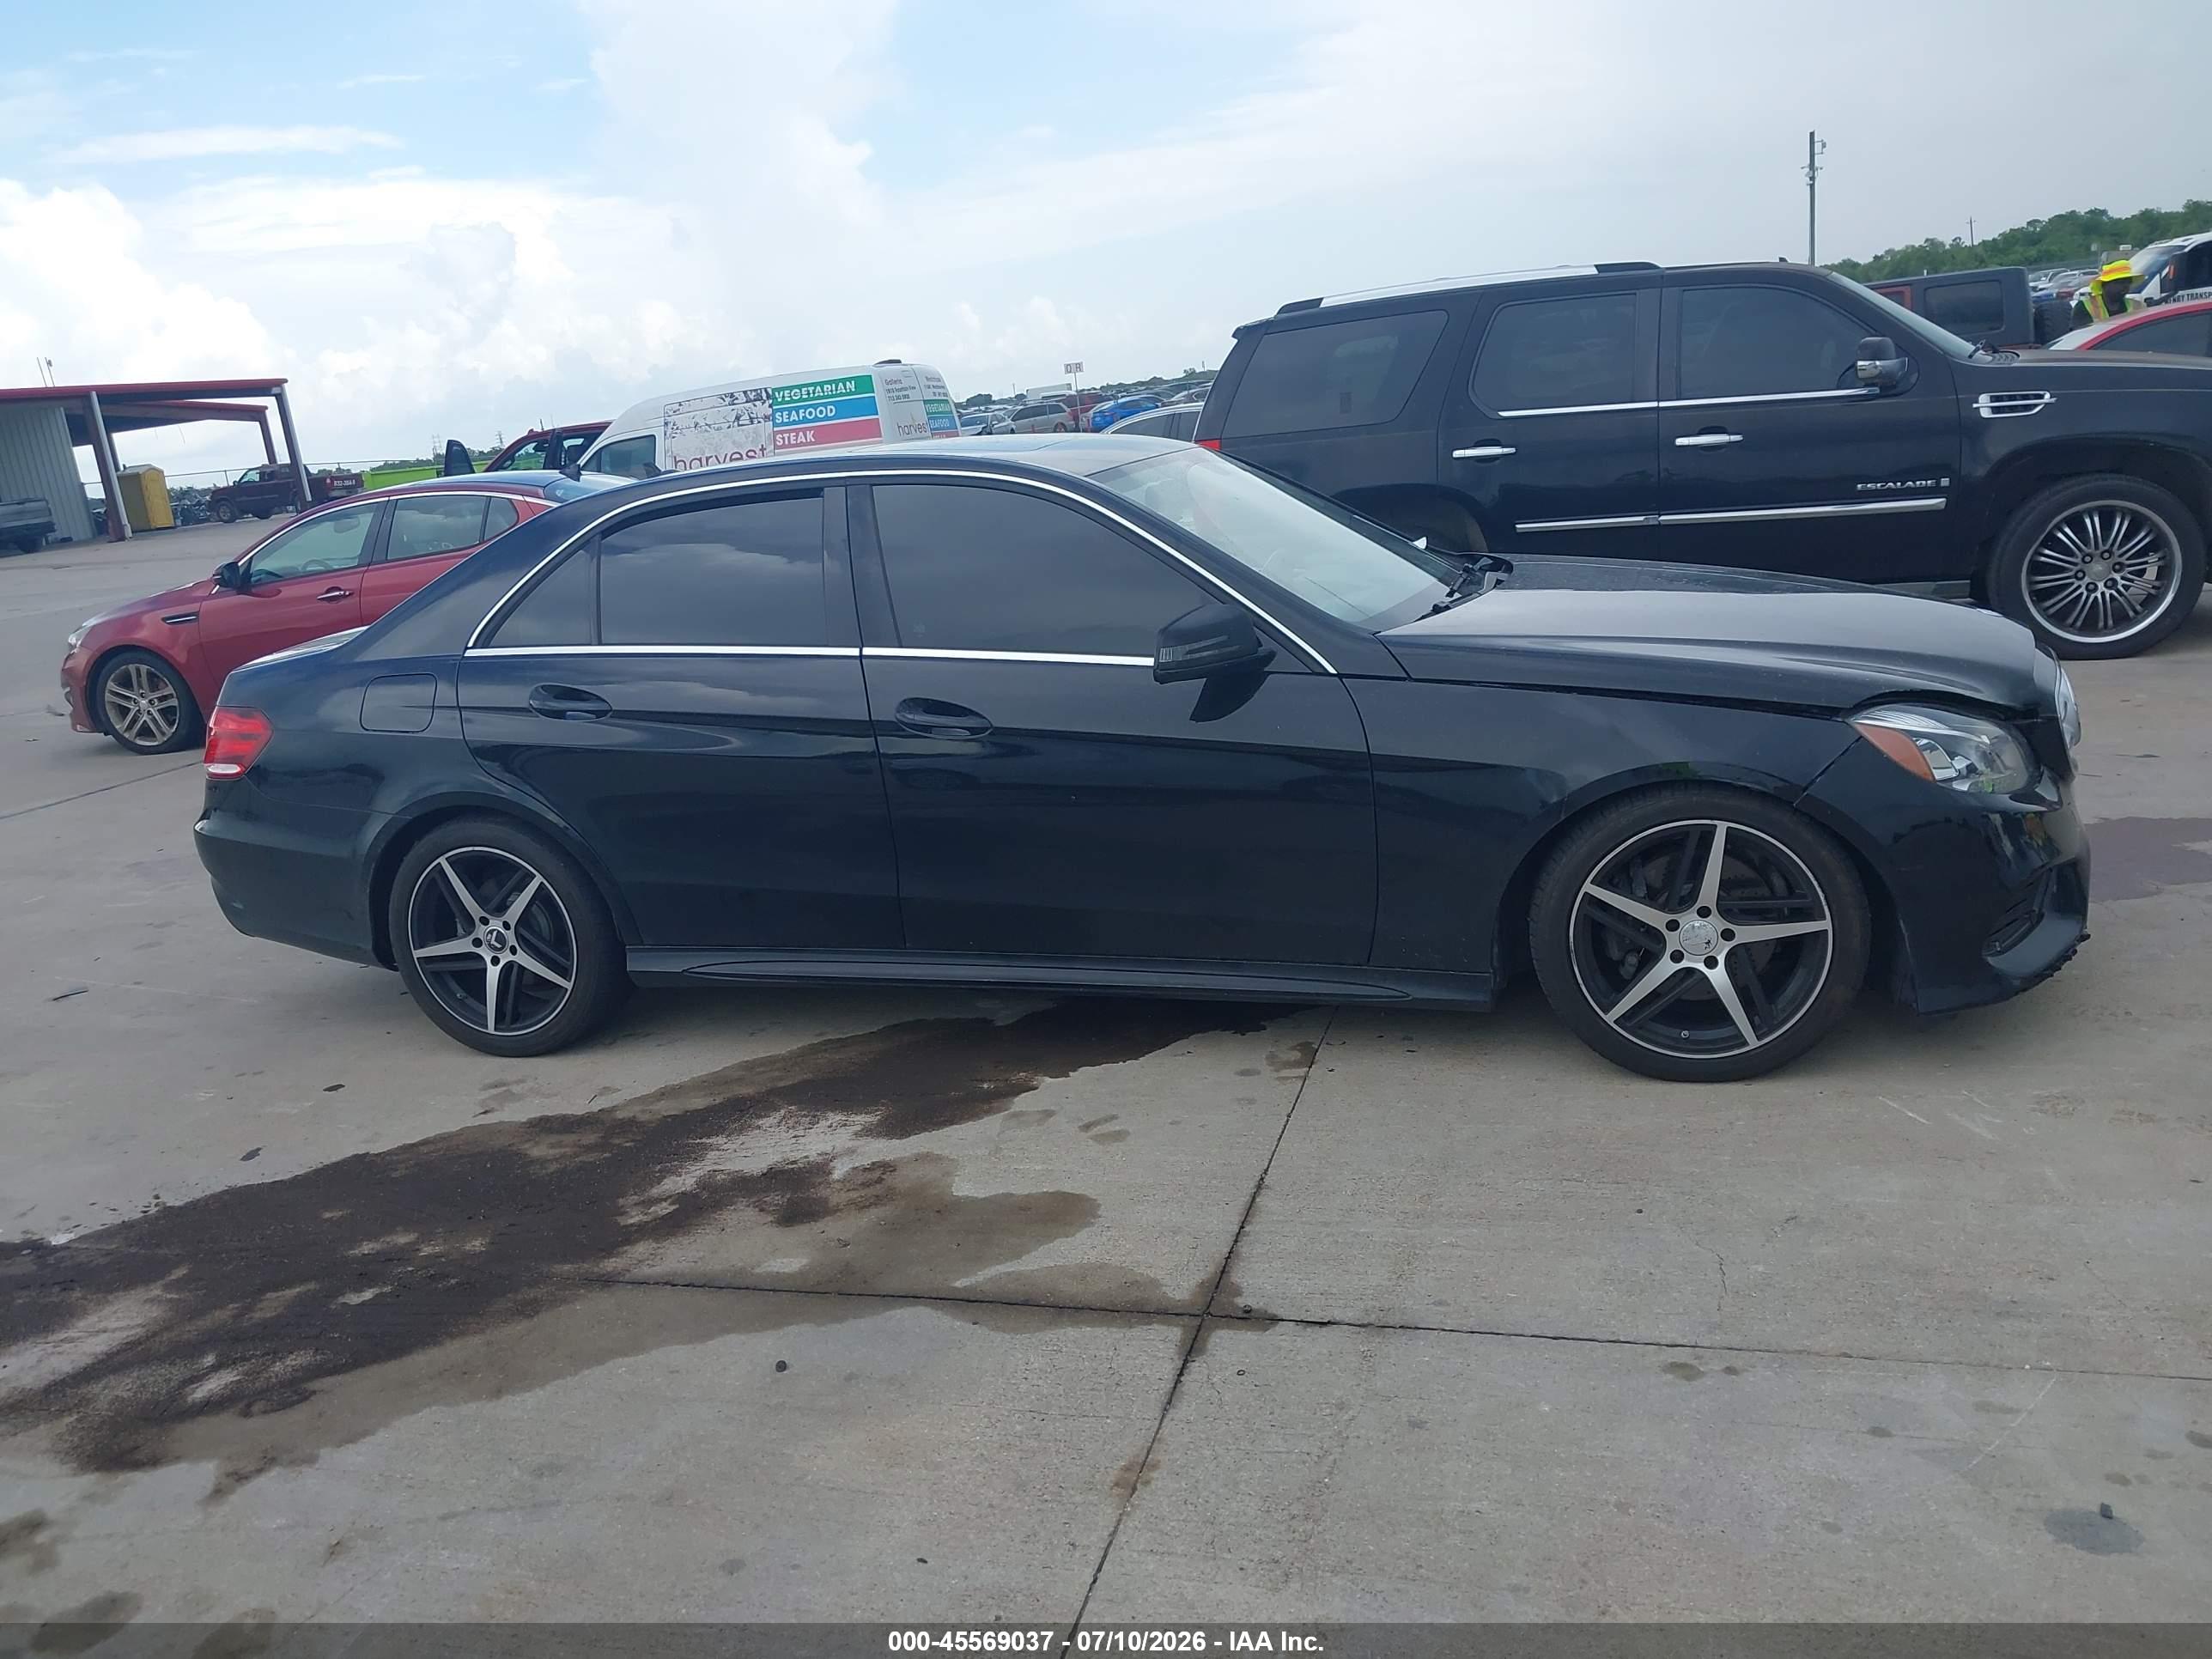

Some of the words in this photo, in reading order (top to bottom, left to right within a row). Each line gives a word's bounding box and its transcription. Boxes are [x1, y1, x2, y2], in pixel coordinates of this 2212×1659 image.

[775, 380, 856, 402] VEGETARIAN
[775, 405, 836, 423] SEAFOOD
[926, 403, 951, 412] VEGETARIAN
[896, 421, 928, 436] harves
[929, 418, 950, 428] SEAFOOD
[775, 430, 816, 446] STEAK
[673, 443, 767, 471] harvest
[1856, 480, 1937, 490] ESCALADE
